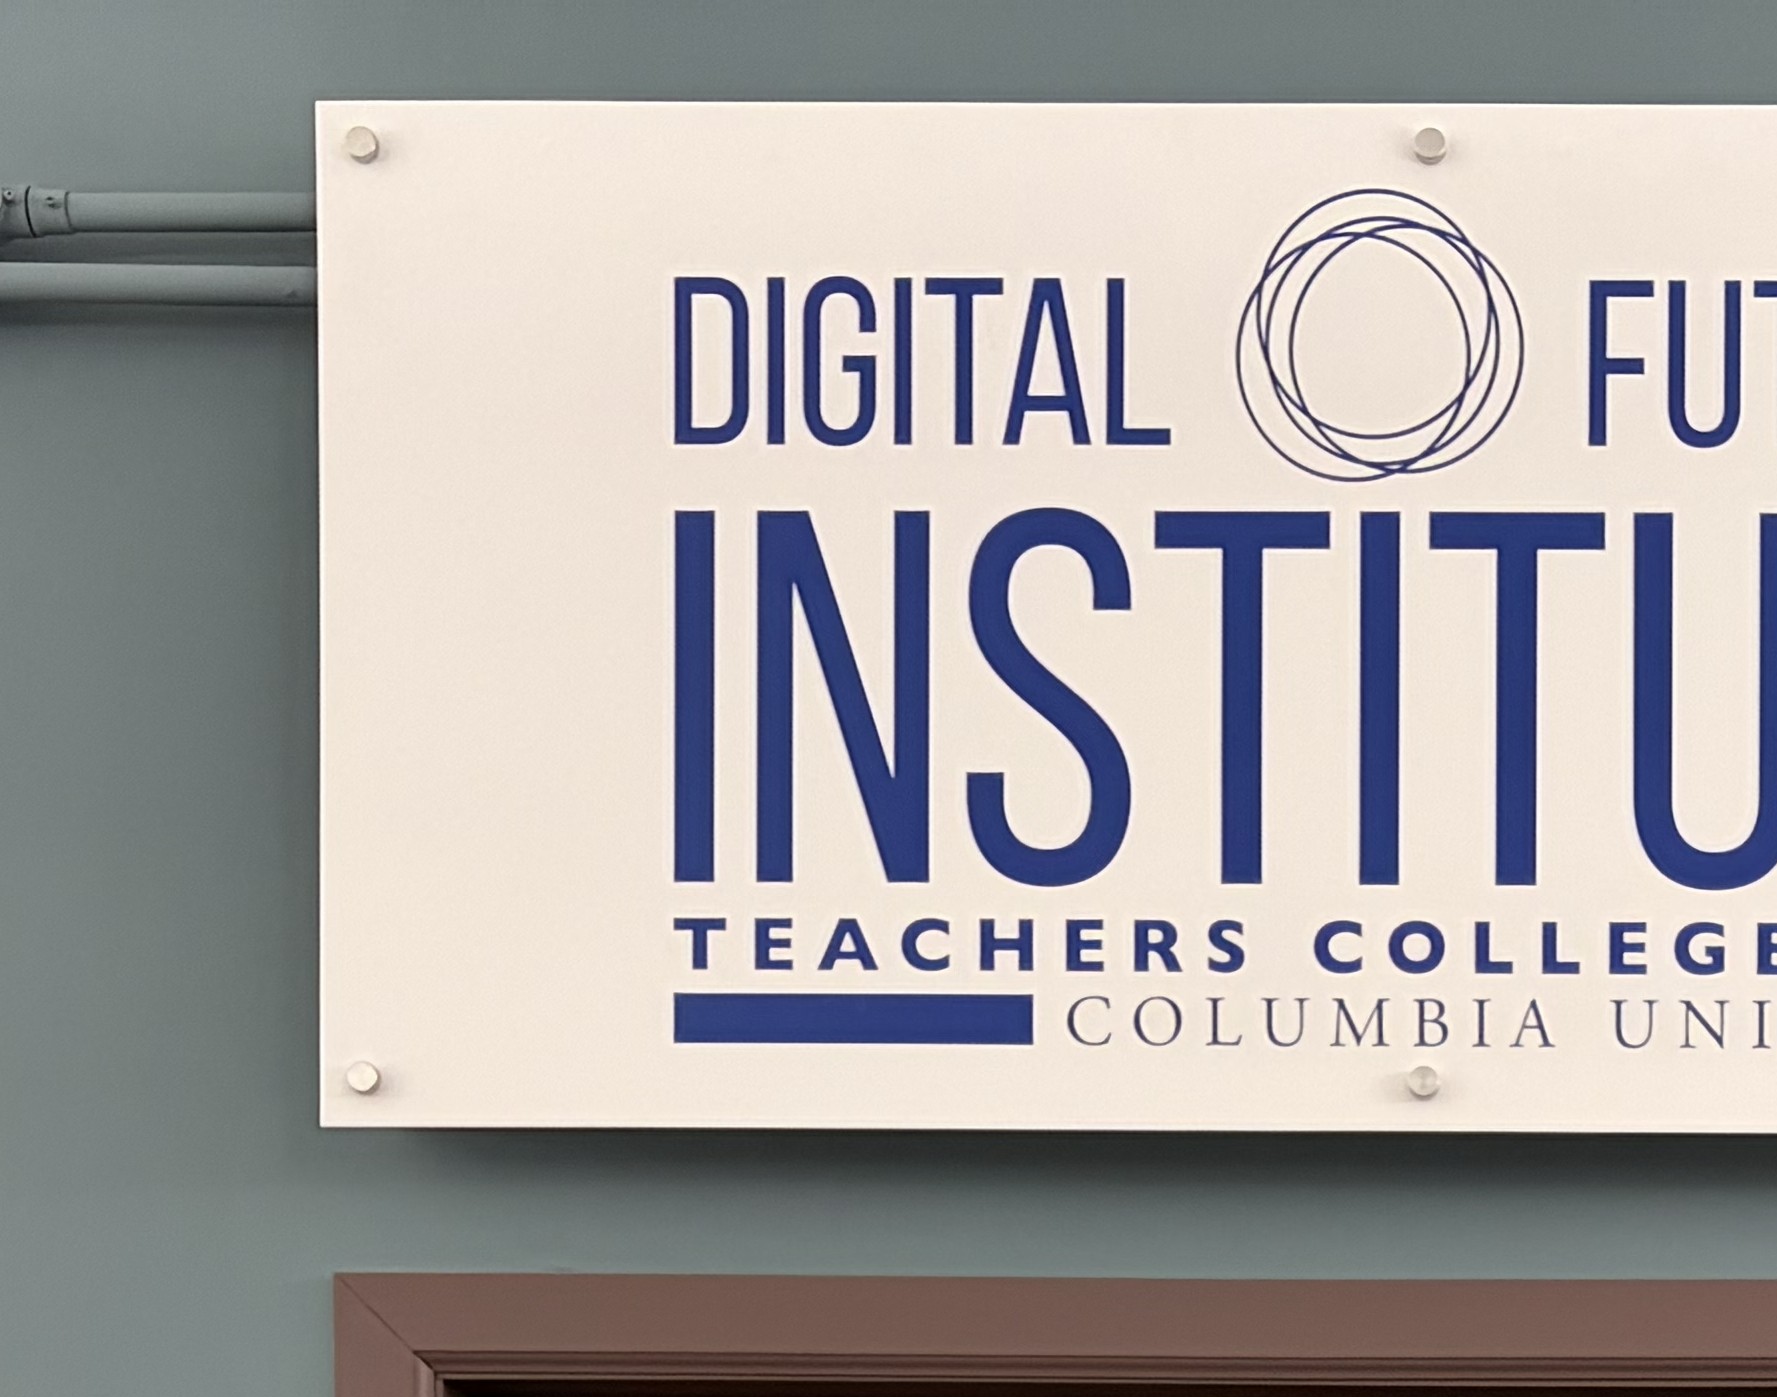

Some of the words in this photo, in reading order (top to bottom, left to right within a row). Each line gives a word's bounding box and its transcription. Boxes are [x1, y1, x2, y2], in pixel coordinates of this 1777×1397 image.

[673, 275, 1173, 447] DIGITAL
[673, 917, 1246, 974] TEACHERS
[1066, 994, 1555, 1048] COLUMBIA
